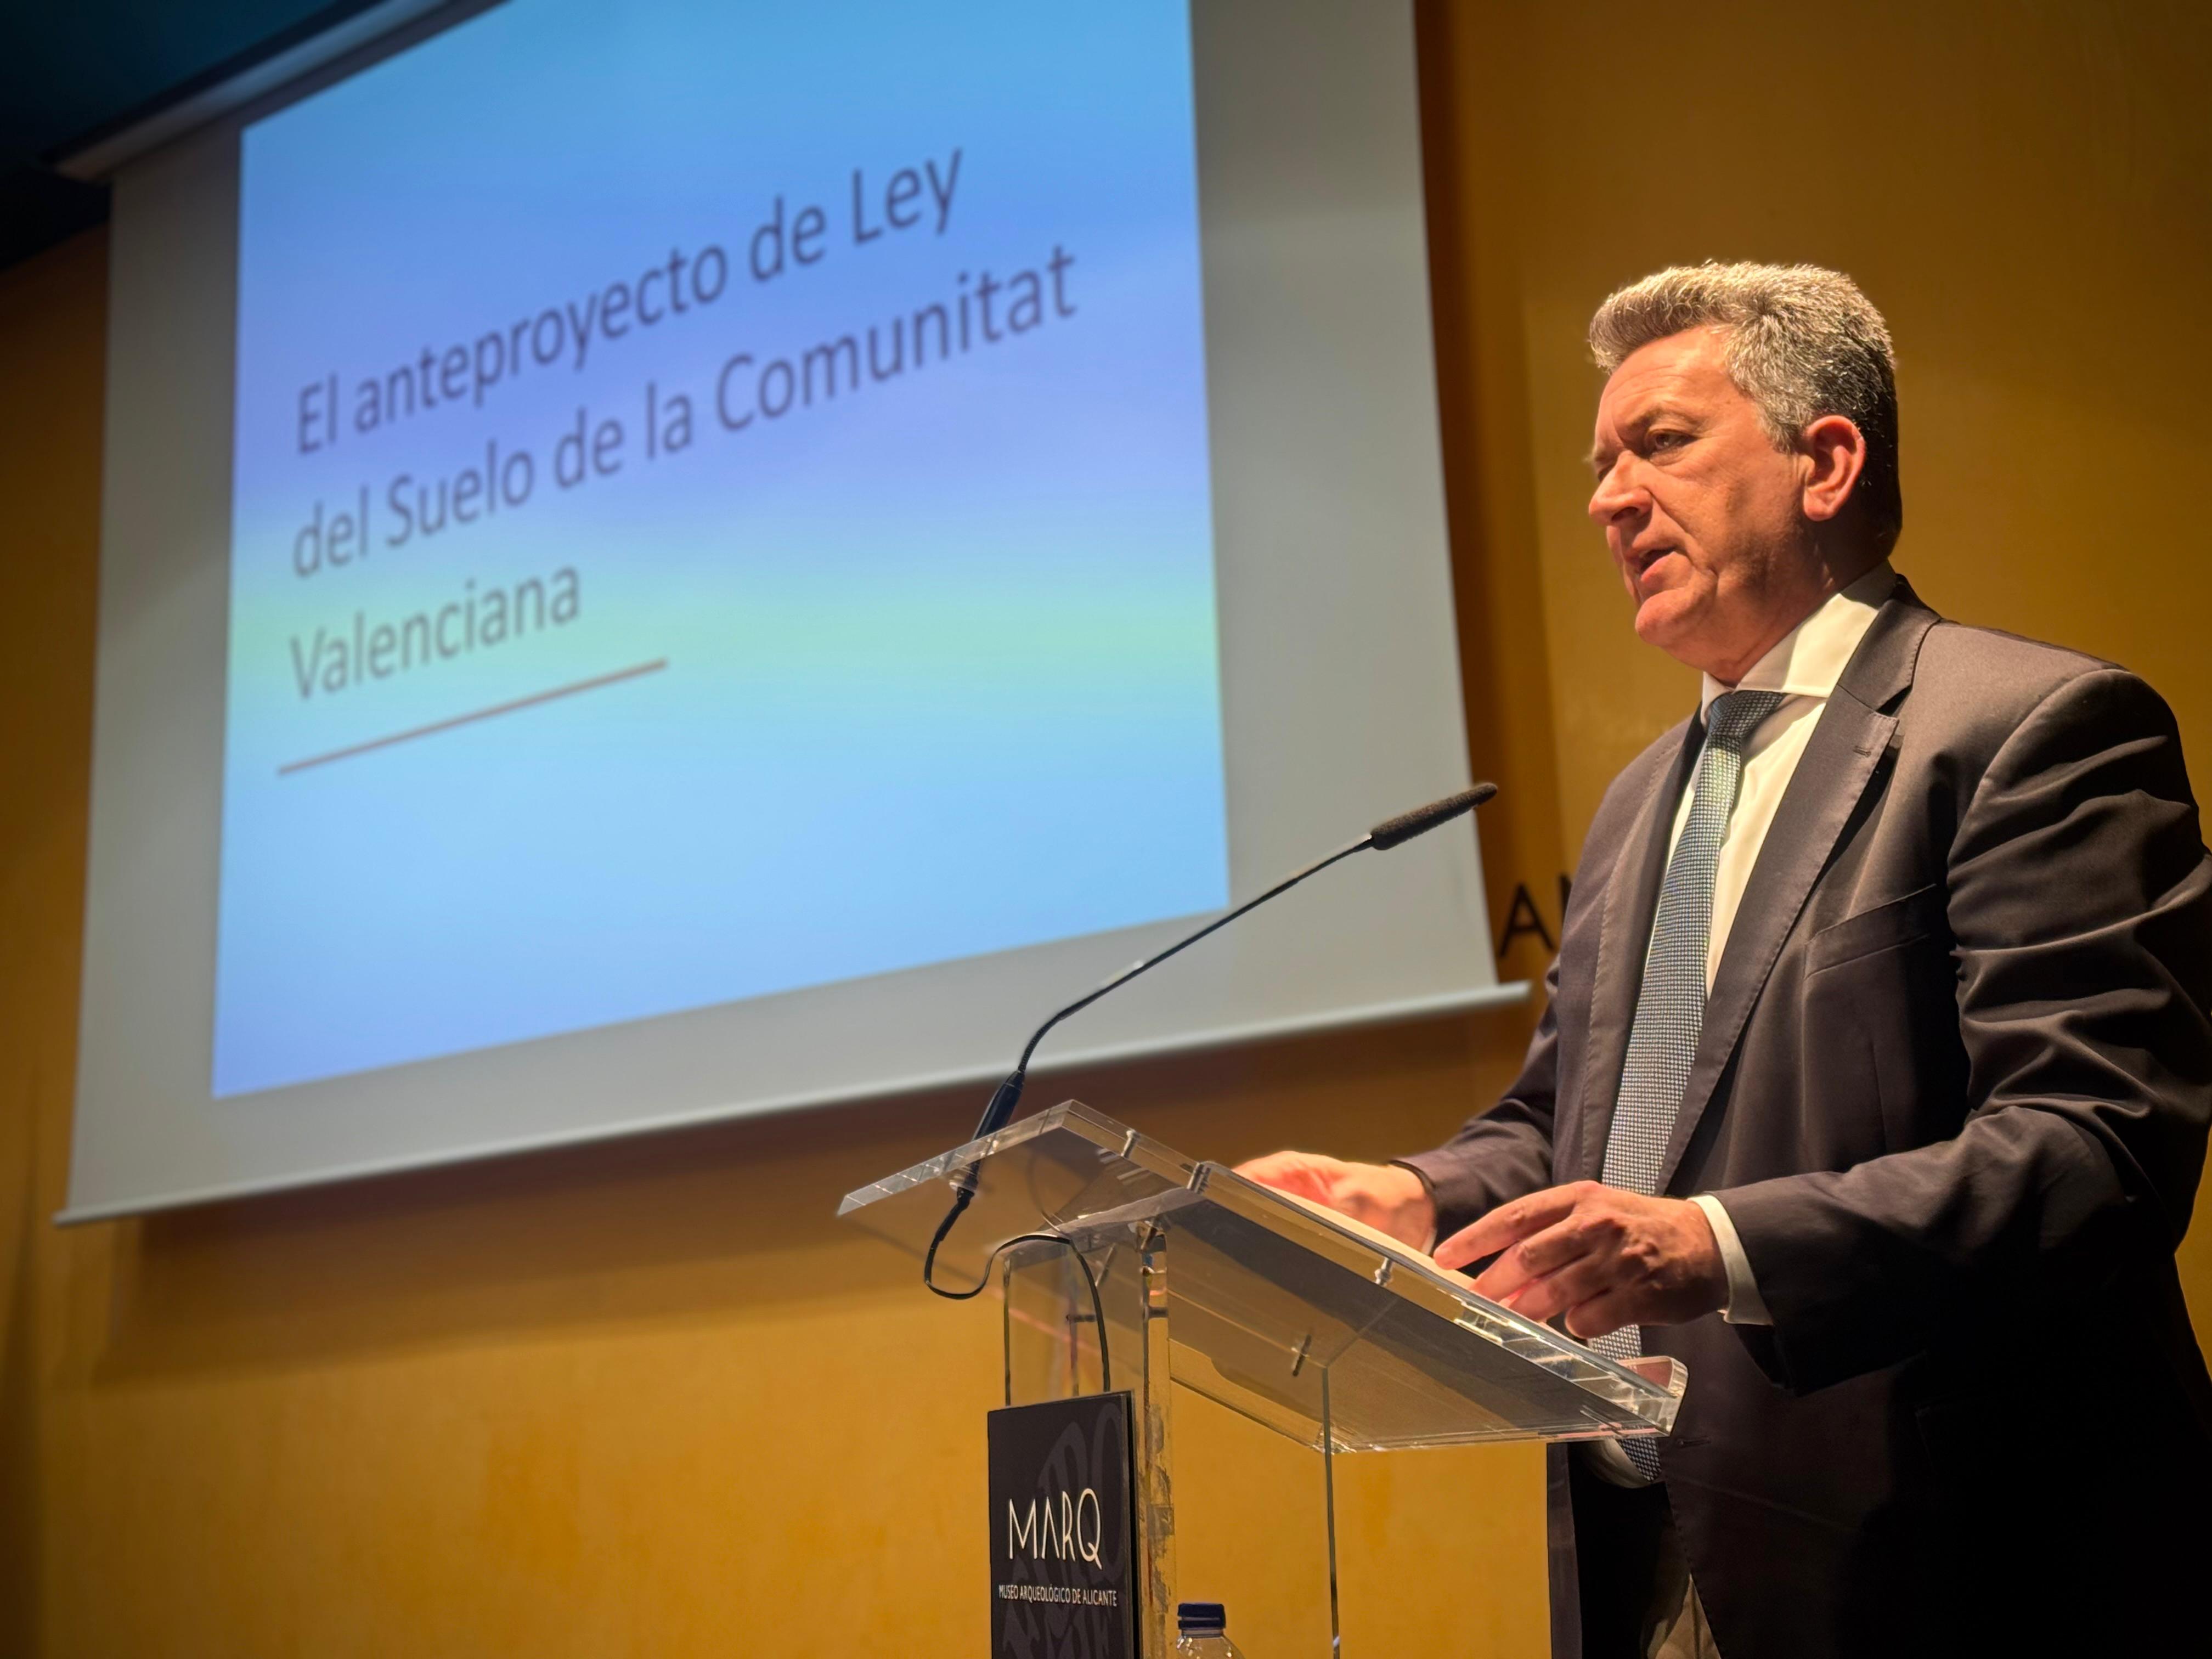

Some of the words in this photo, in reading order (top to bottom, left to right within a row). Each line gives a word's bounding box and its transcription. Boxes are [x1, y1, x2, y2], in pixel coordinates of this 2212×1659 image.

[297, 372, 338, 456] El
[353, 242, 728, 436] anteproyecto
[749, 192, 827, 282] de
[850, 147, 963, 246] Ley
[292, 483, 369, 579] del
[385, 438, 535, 550] Suelo
[554, 405, 625, 490] de
[645, 380, 693, 461] la
[716, 244, 1077, 432] Comunitat
[289, 565, 580, 701] Valenciana
[998, 1584, 1019, 1600] MUSEO
[1020, 1583, 1071, 1604] ARQUEOLÓGICO
[1073, 1588, 1081, 1604] DE
[1082, 1589, 1117, 1607] ALICANTE
[1009, 1488, 1102, 1570] MARQ
